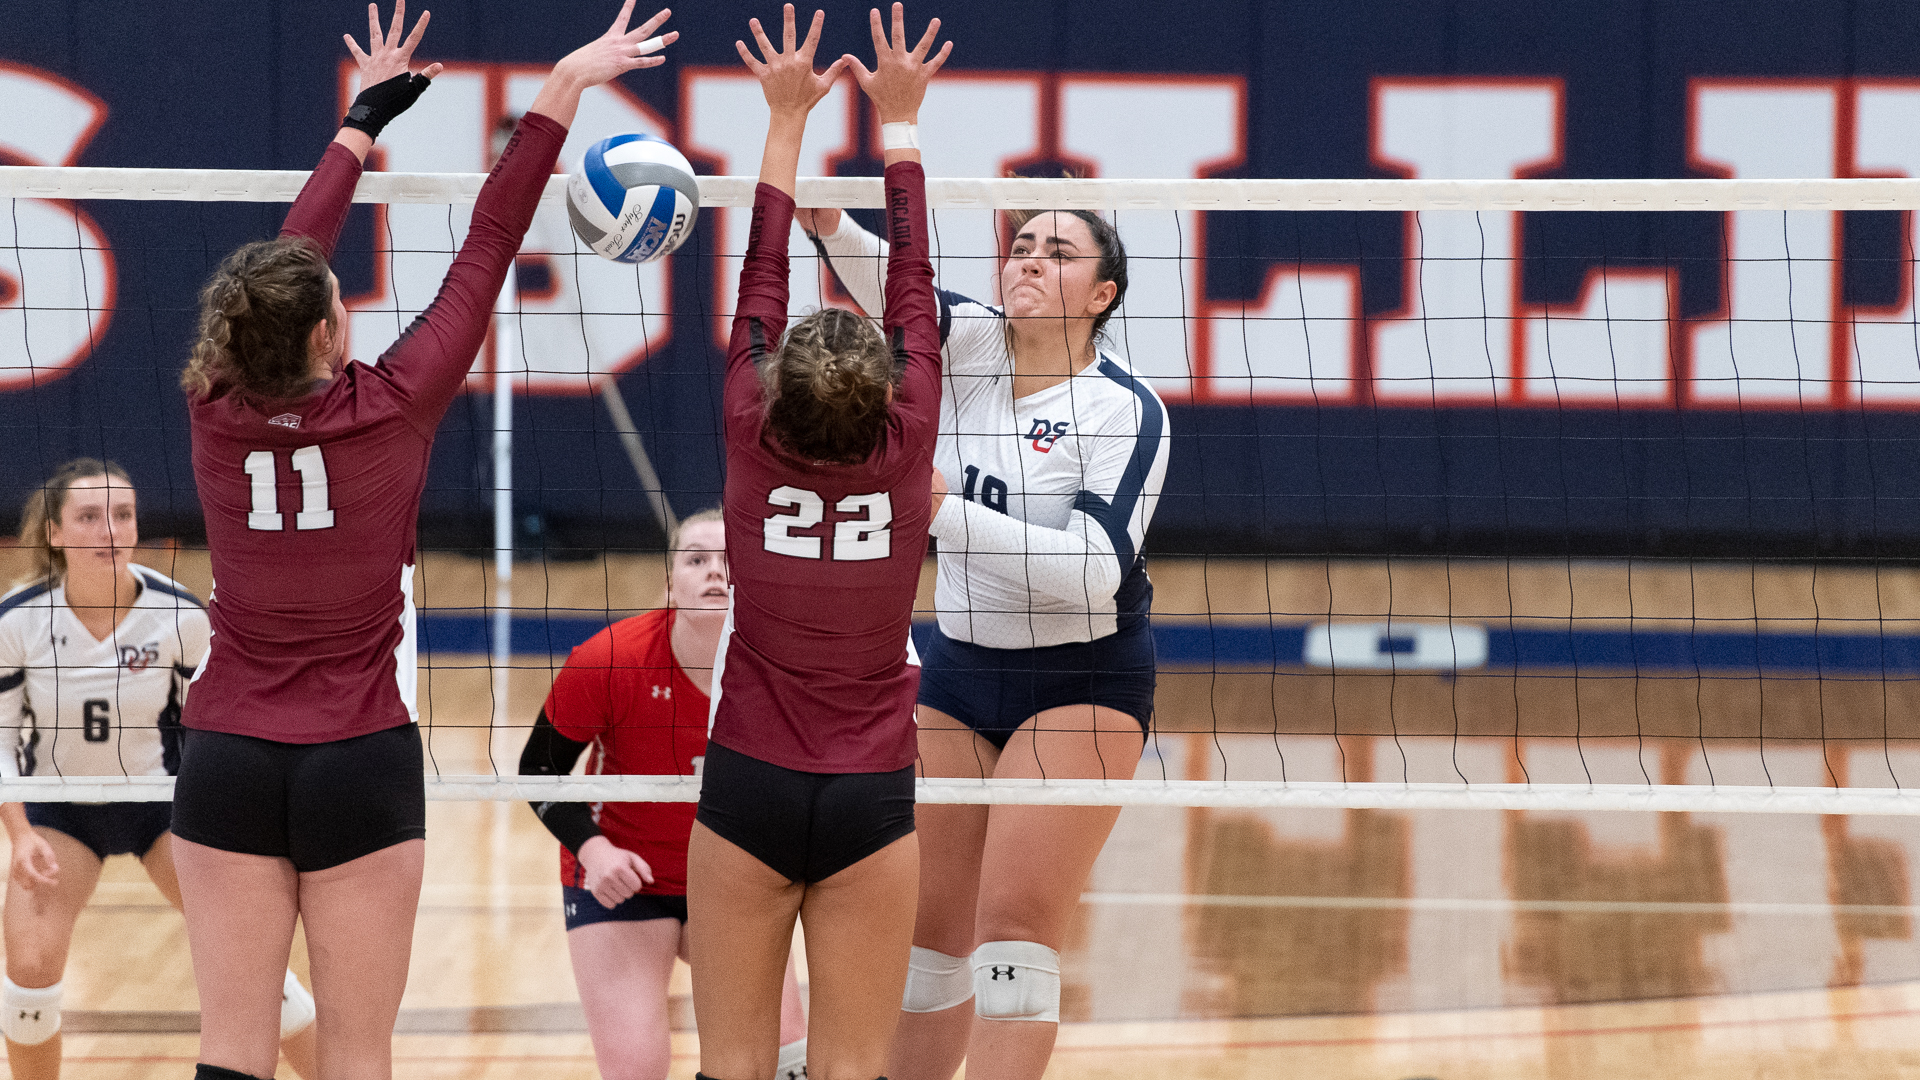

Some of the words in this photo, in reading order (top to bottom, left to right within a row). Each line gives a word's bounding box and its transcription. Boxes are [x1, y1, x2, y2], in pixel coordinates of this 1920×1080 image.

[621, 204, 643, 232] Super
[627, 216, 668, 261] NCAA
[891, 187, 912, 250] ARCADIA
[243, 444, 336, 532] 11
[763, 484, 893, 562] 22
[83, 698, 110, 743] 6
